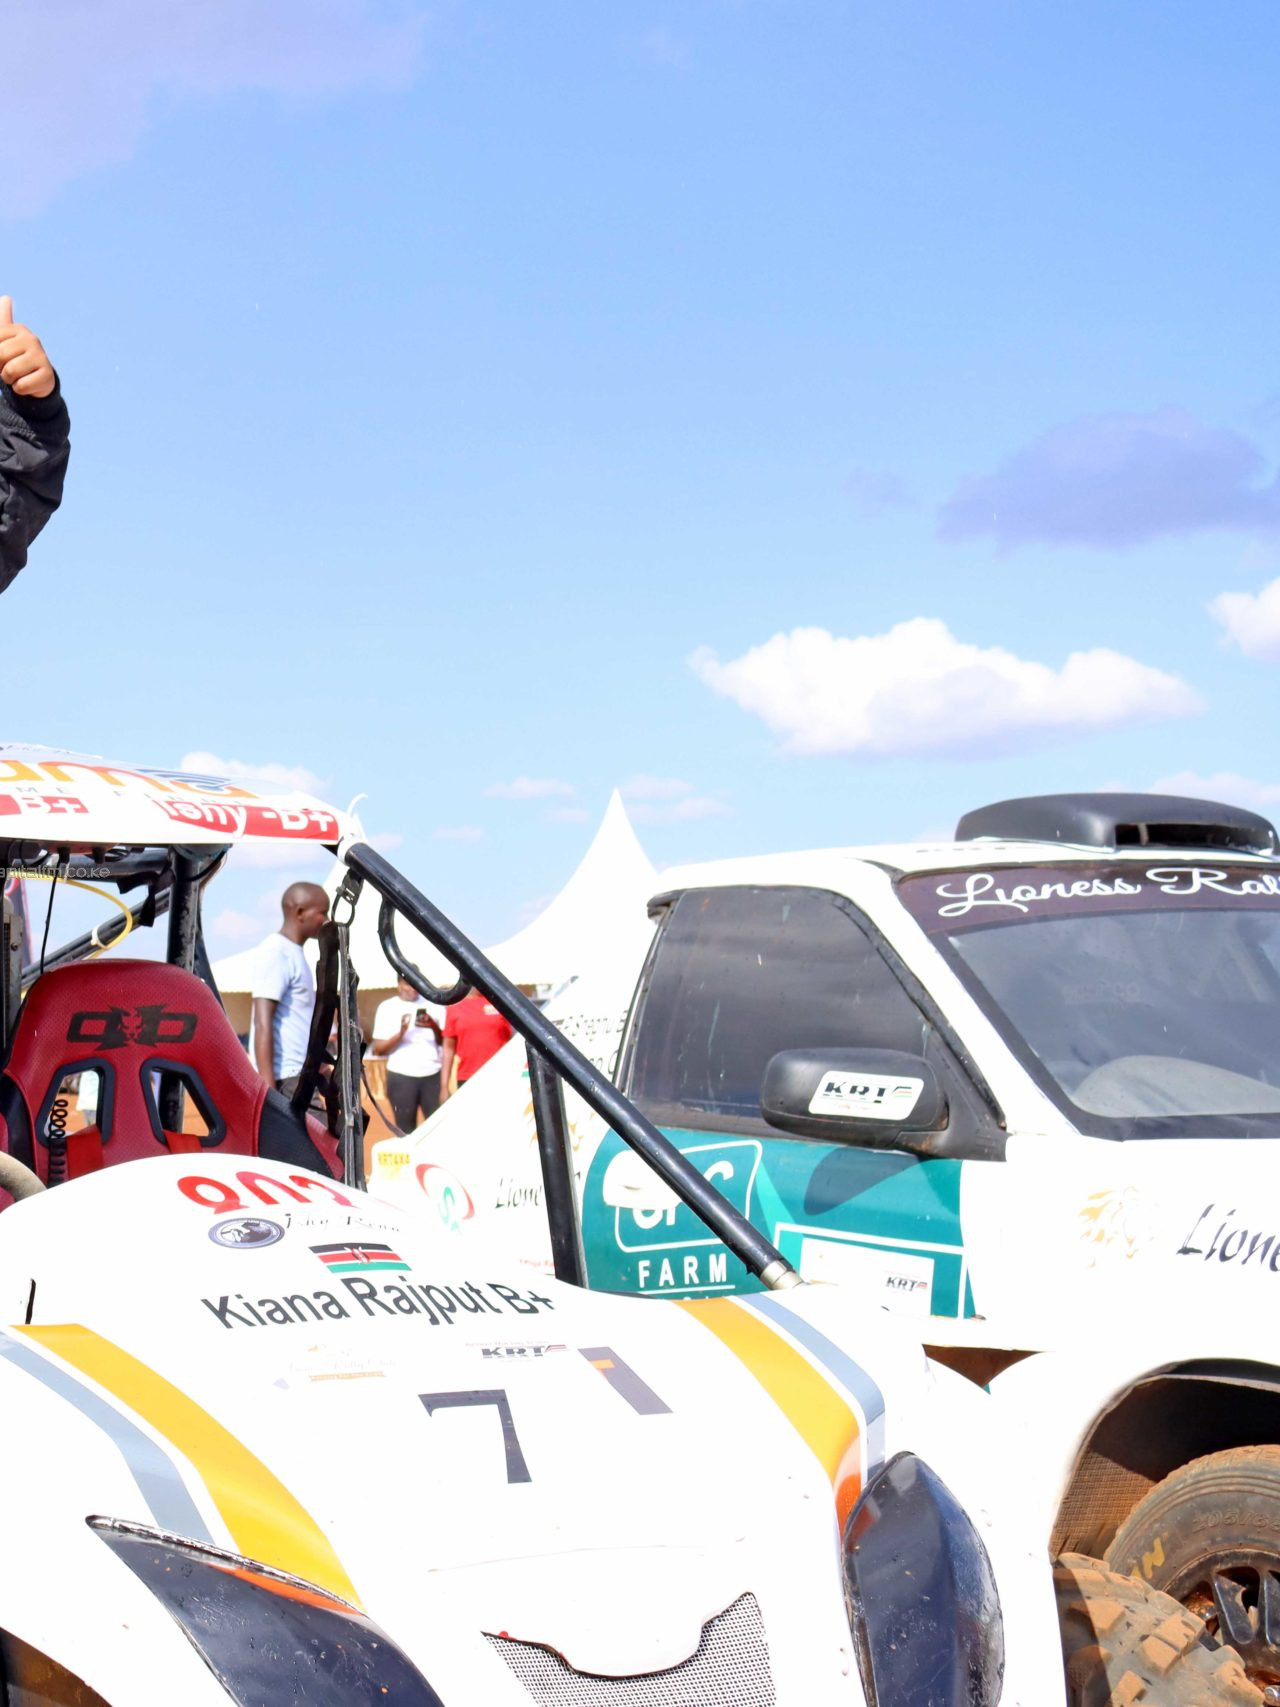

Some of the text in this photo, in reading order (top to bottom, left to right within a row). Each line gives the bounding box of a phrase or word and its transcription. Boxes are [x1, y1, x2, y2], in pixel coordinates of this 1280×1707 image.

[936, 868, 1280, 917] Lioness Ral
[638, 1253, 727, 1288] FARM
[200, 1275, 555, 1329] Kiana Rajput B+
[481, 1346, 545, 1358] KRT
